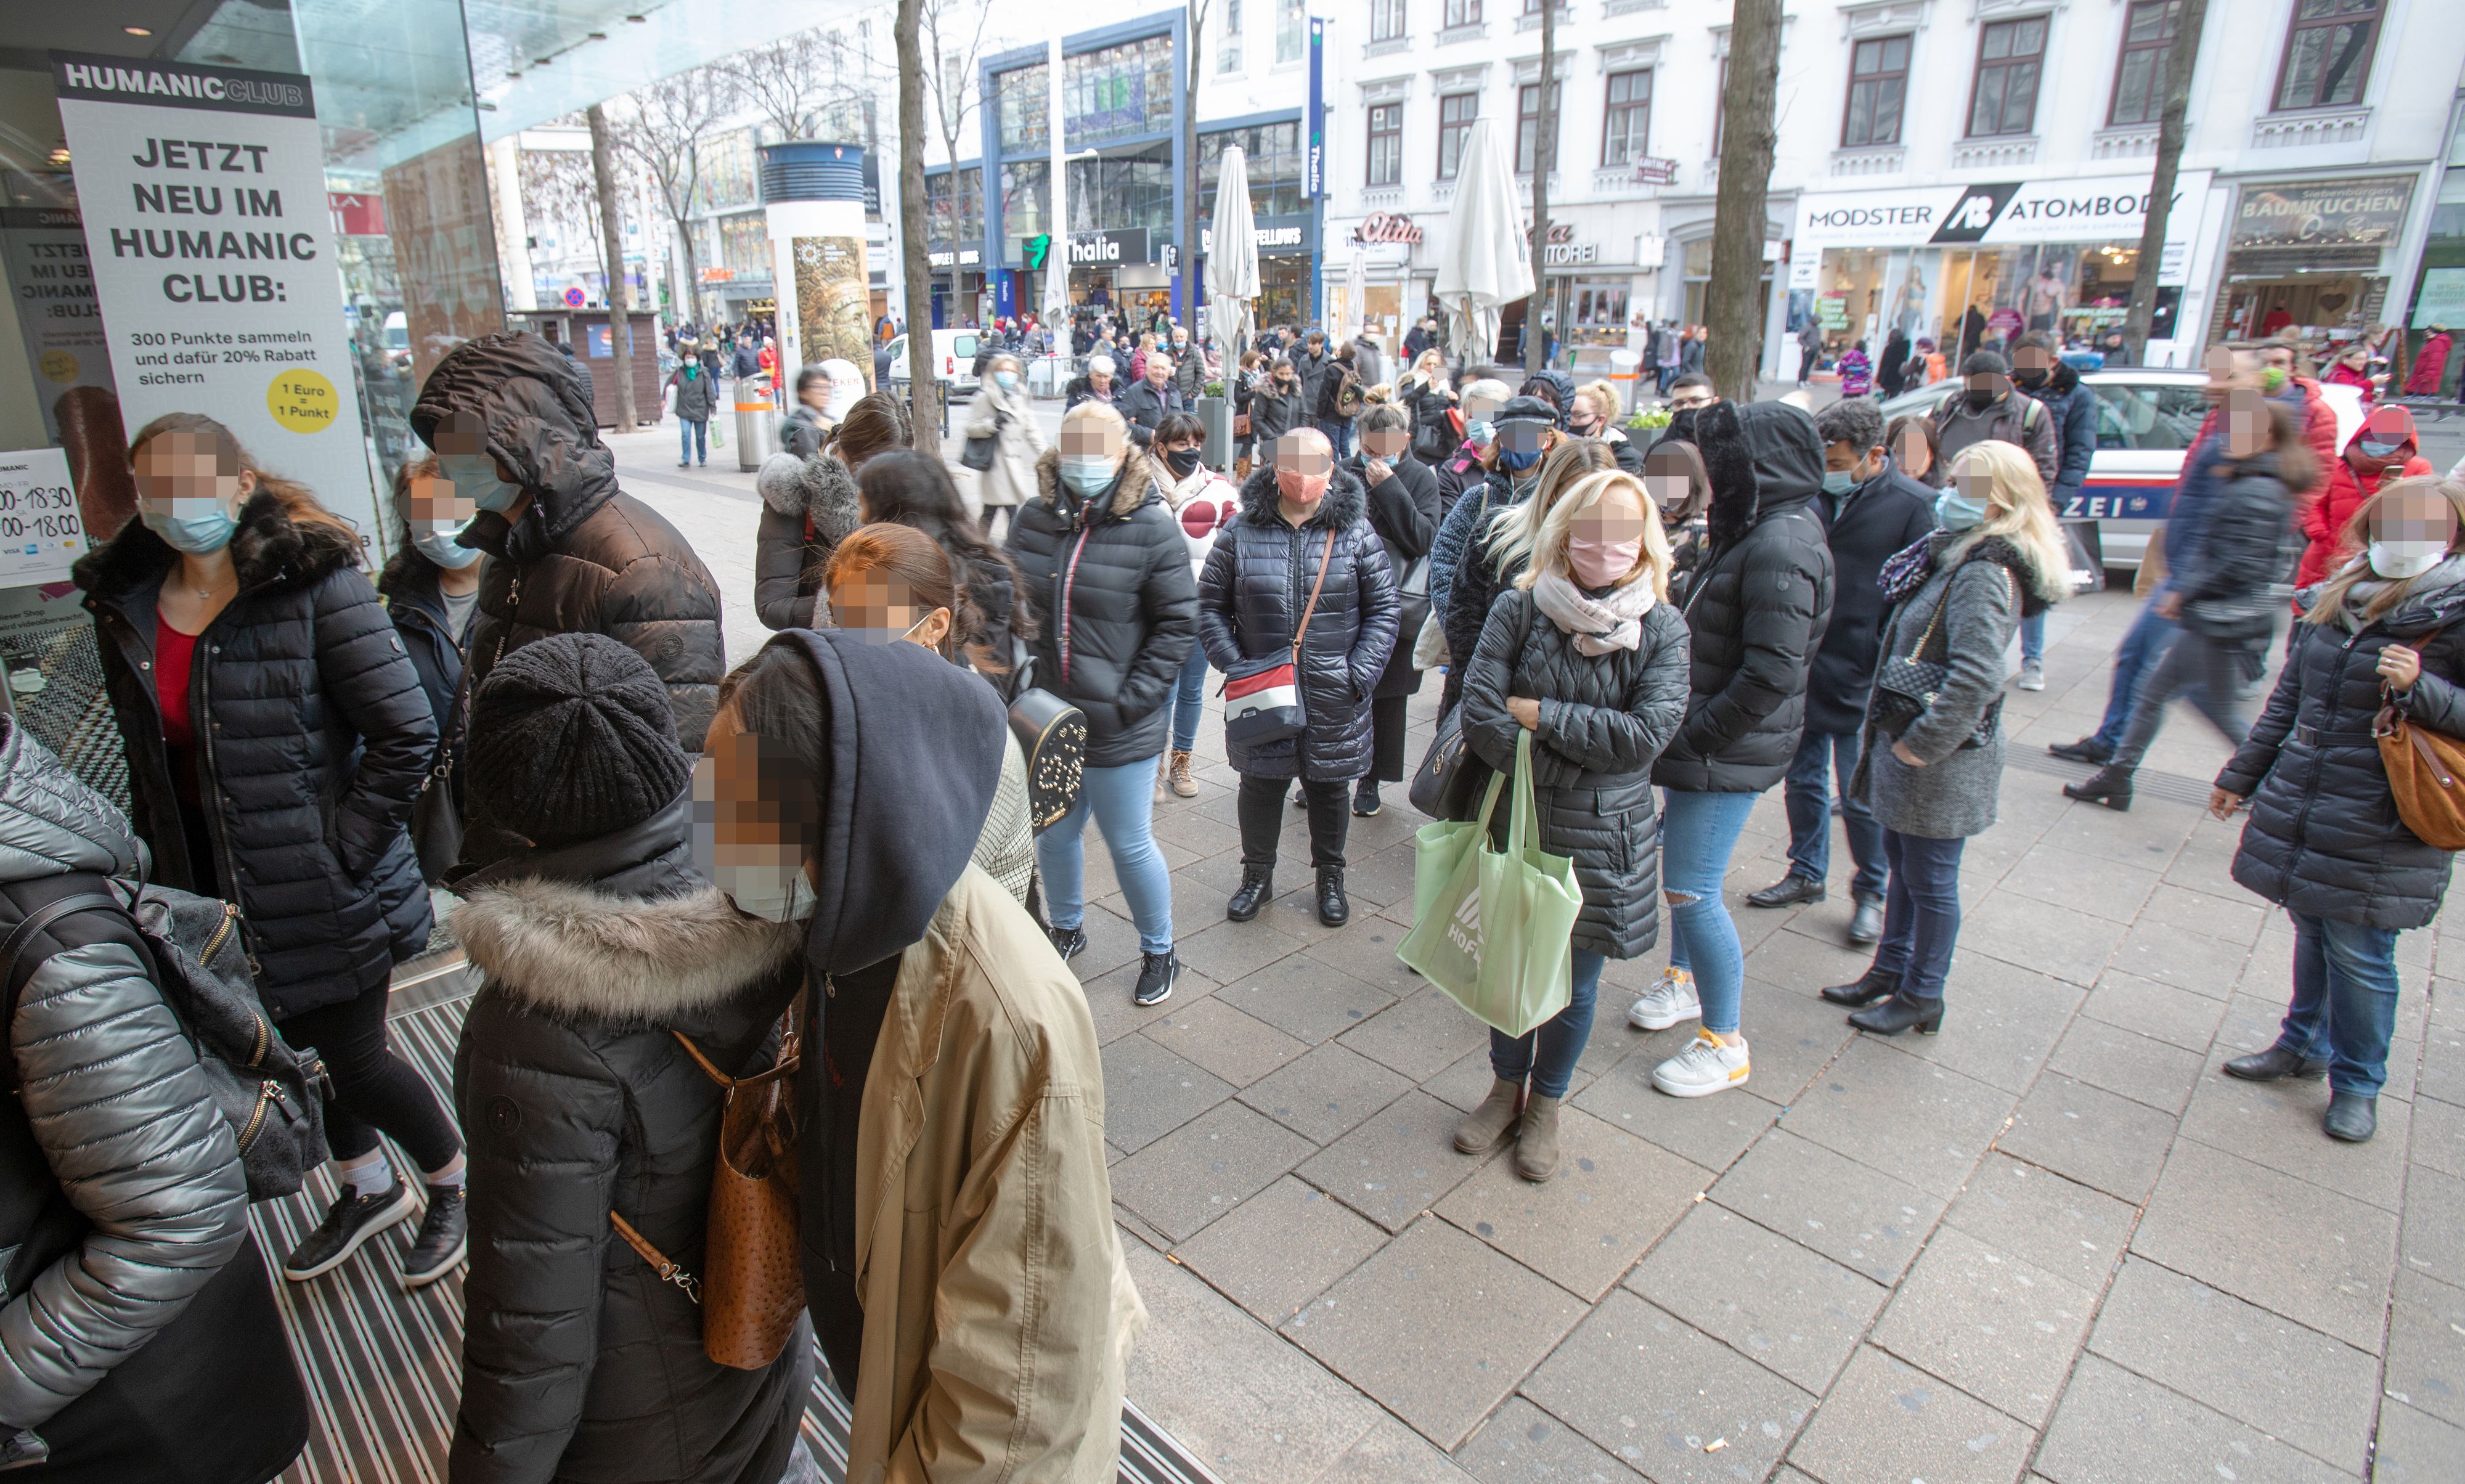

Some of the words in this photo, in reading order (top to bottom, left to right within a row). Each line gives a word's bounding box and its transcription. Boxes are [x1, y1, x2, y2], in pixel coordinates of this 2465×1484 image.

[132, 138, 268, 173] JETZT
[1311, 145, 1320, 193] Thalia
[132, 183, 222, 215] NEU
[235, 187, 283, 217] IM
[2242, 195, 2403, 218] BAUMKUCHEN
[1809, 206, 1933, 227] MODSTER
[110, 227, 317, 261] HUMANIC
[1067, 235, 1120, 263] Thalia
[163, 274, 287, 303] CLUB:
[131, 333, 166, 346] 300
[171, 332, 233, 345] Punkte
[238, 330, 312, 344] sammeln
[135, 353, 169, 365] und
[173, 351, 218, 365] dafür
[222, 349, 261, 363] 20%
[264, 349, 317, 362] Rabatt
[139, 372, 205, 385] sichern
[832, 378, 860, 387] EKEN
[282, 383, 289, 394] 1
[294, 384, 325, 397] Euro
[279, 406, 285, 416] 1
[290, 406, 330, 420] Punkt
[2062, 496, 2123, 518] ZEI
[23, 610, 46, 618] Shop
